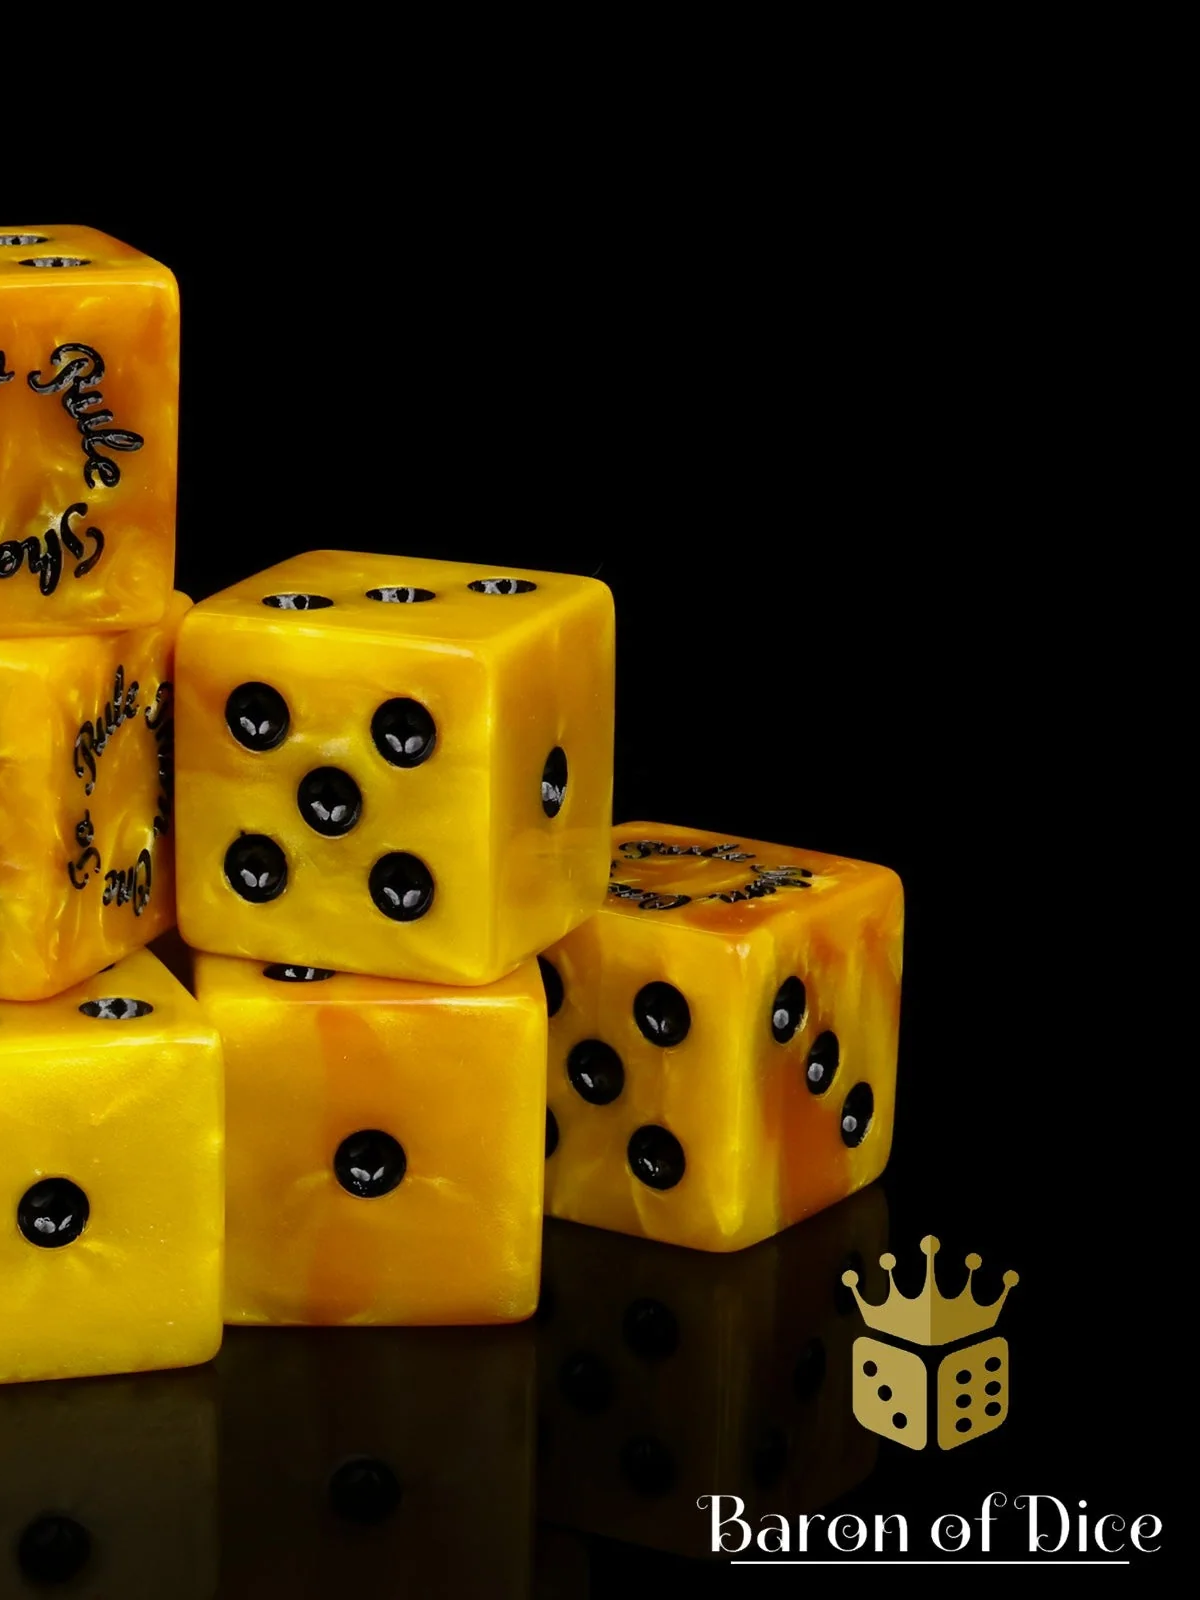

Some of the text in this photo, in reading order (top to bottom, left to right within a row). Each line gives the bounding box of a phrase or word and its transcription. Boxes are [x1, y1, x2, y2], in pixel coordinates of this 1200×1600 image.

[26, 342, 145, 490] Rule
[73, 664, 140, 796] Rule
[67, 808, 102, 890] To
[102, 847, 151, 917] One
